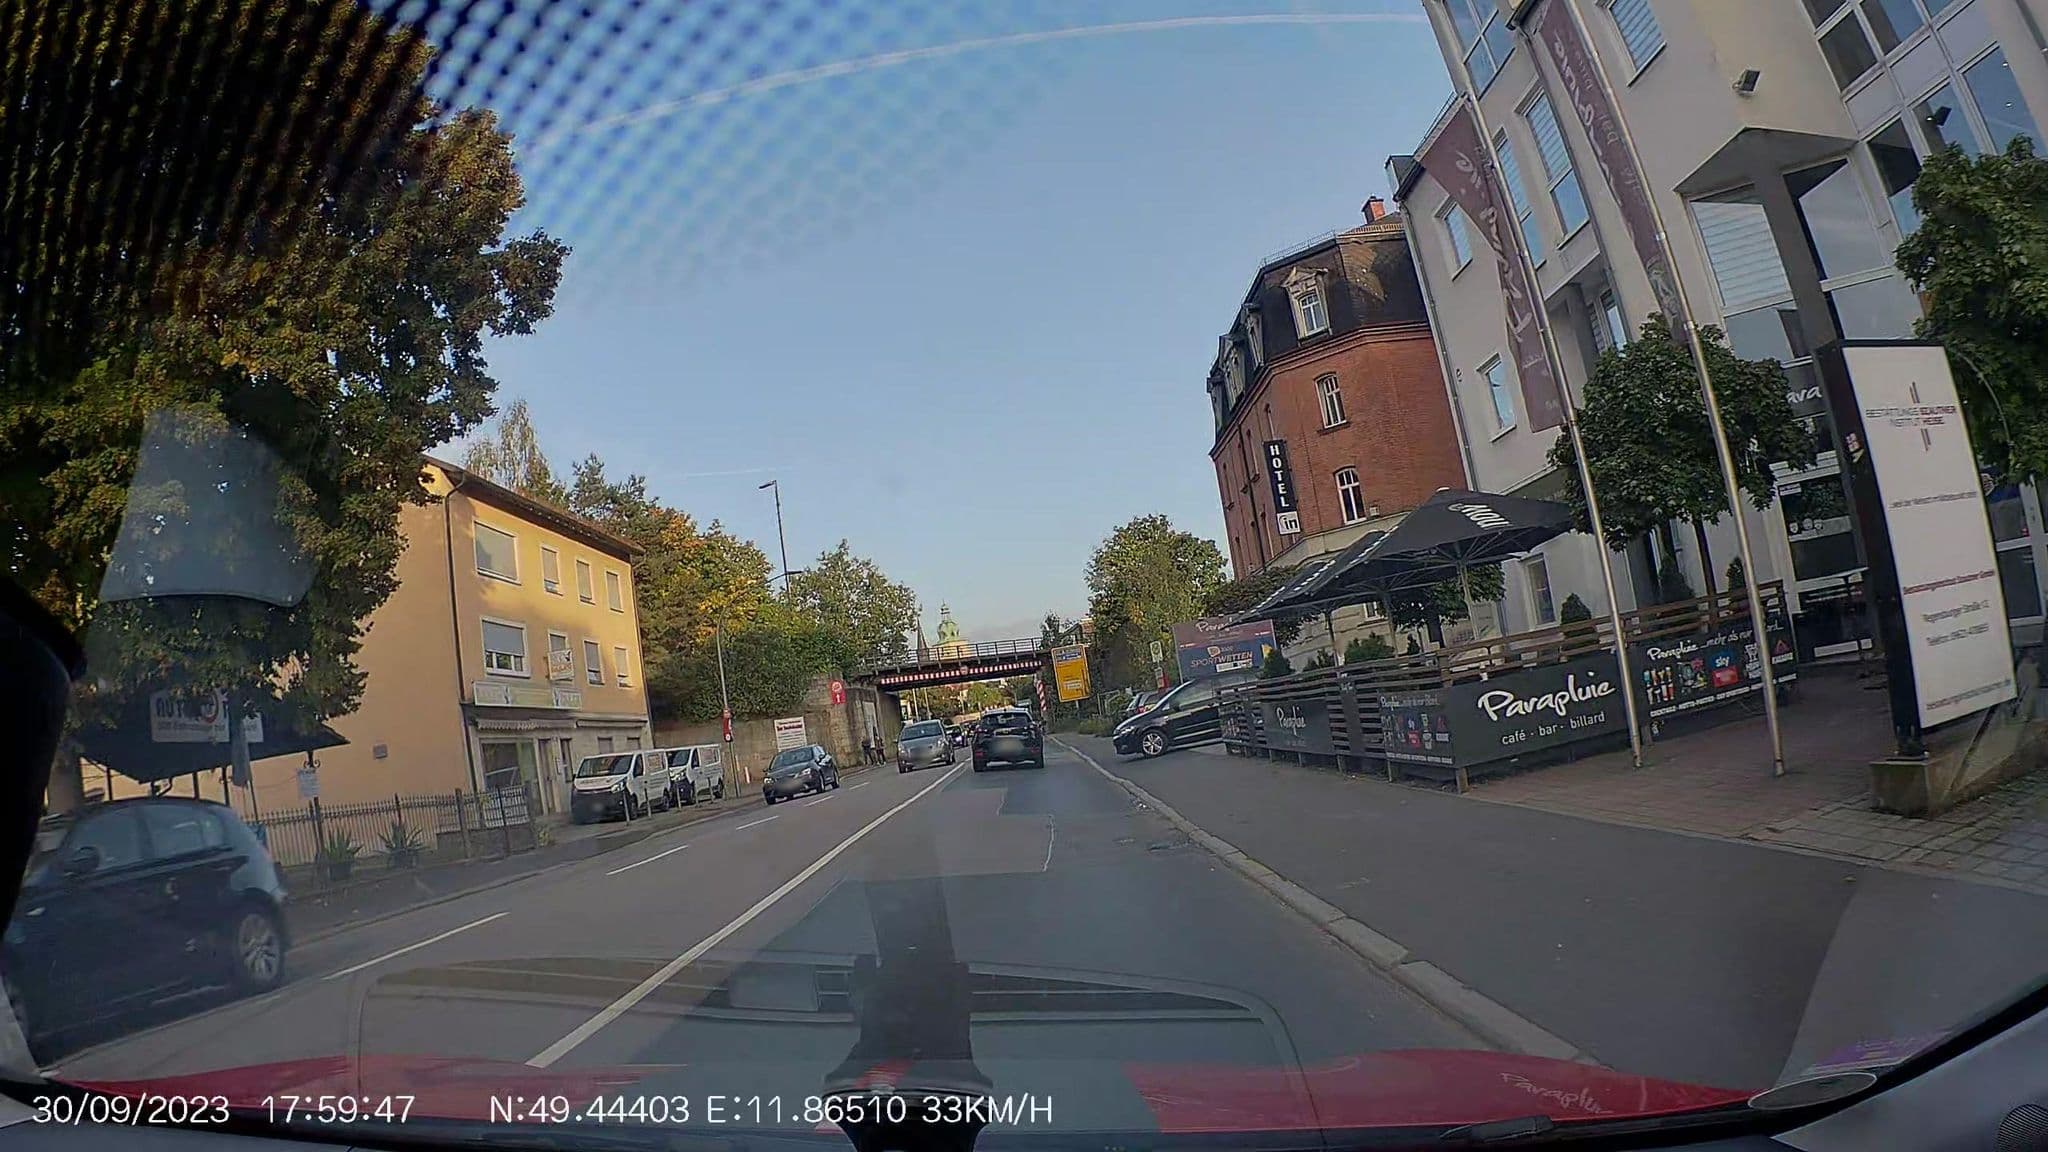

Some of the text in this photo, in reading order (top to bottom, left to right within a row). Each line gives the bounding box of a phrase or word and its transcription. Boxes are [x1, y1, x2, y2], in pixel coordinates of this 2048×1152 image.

[1269, 444, 1290, 508] HOTEL
[1283, 517, 1298, 530] in
[1190, 651, 1254, 668] SPORTWETTEN
[1714, 655, 1730, 668] sky
[1477, 670, 1617, 722] Parapluie
[1501, 711, 1606, 746] café bar billard
